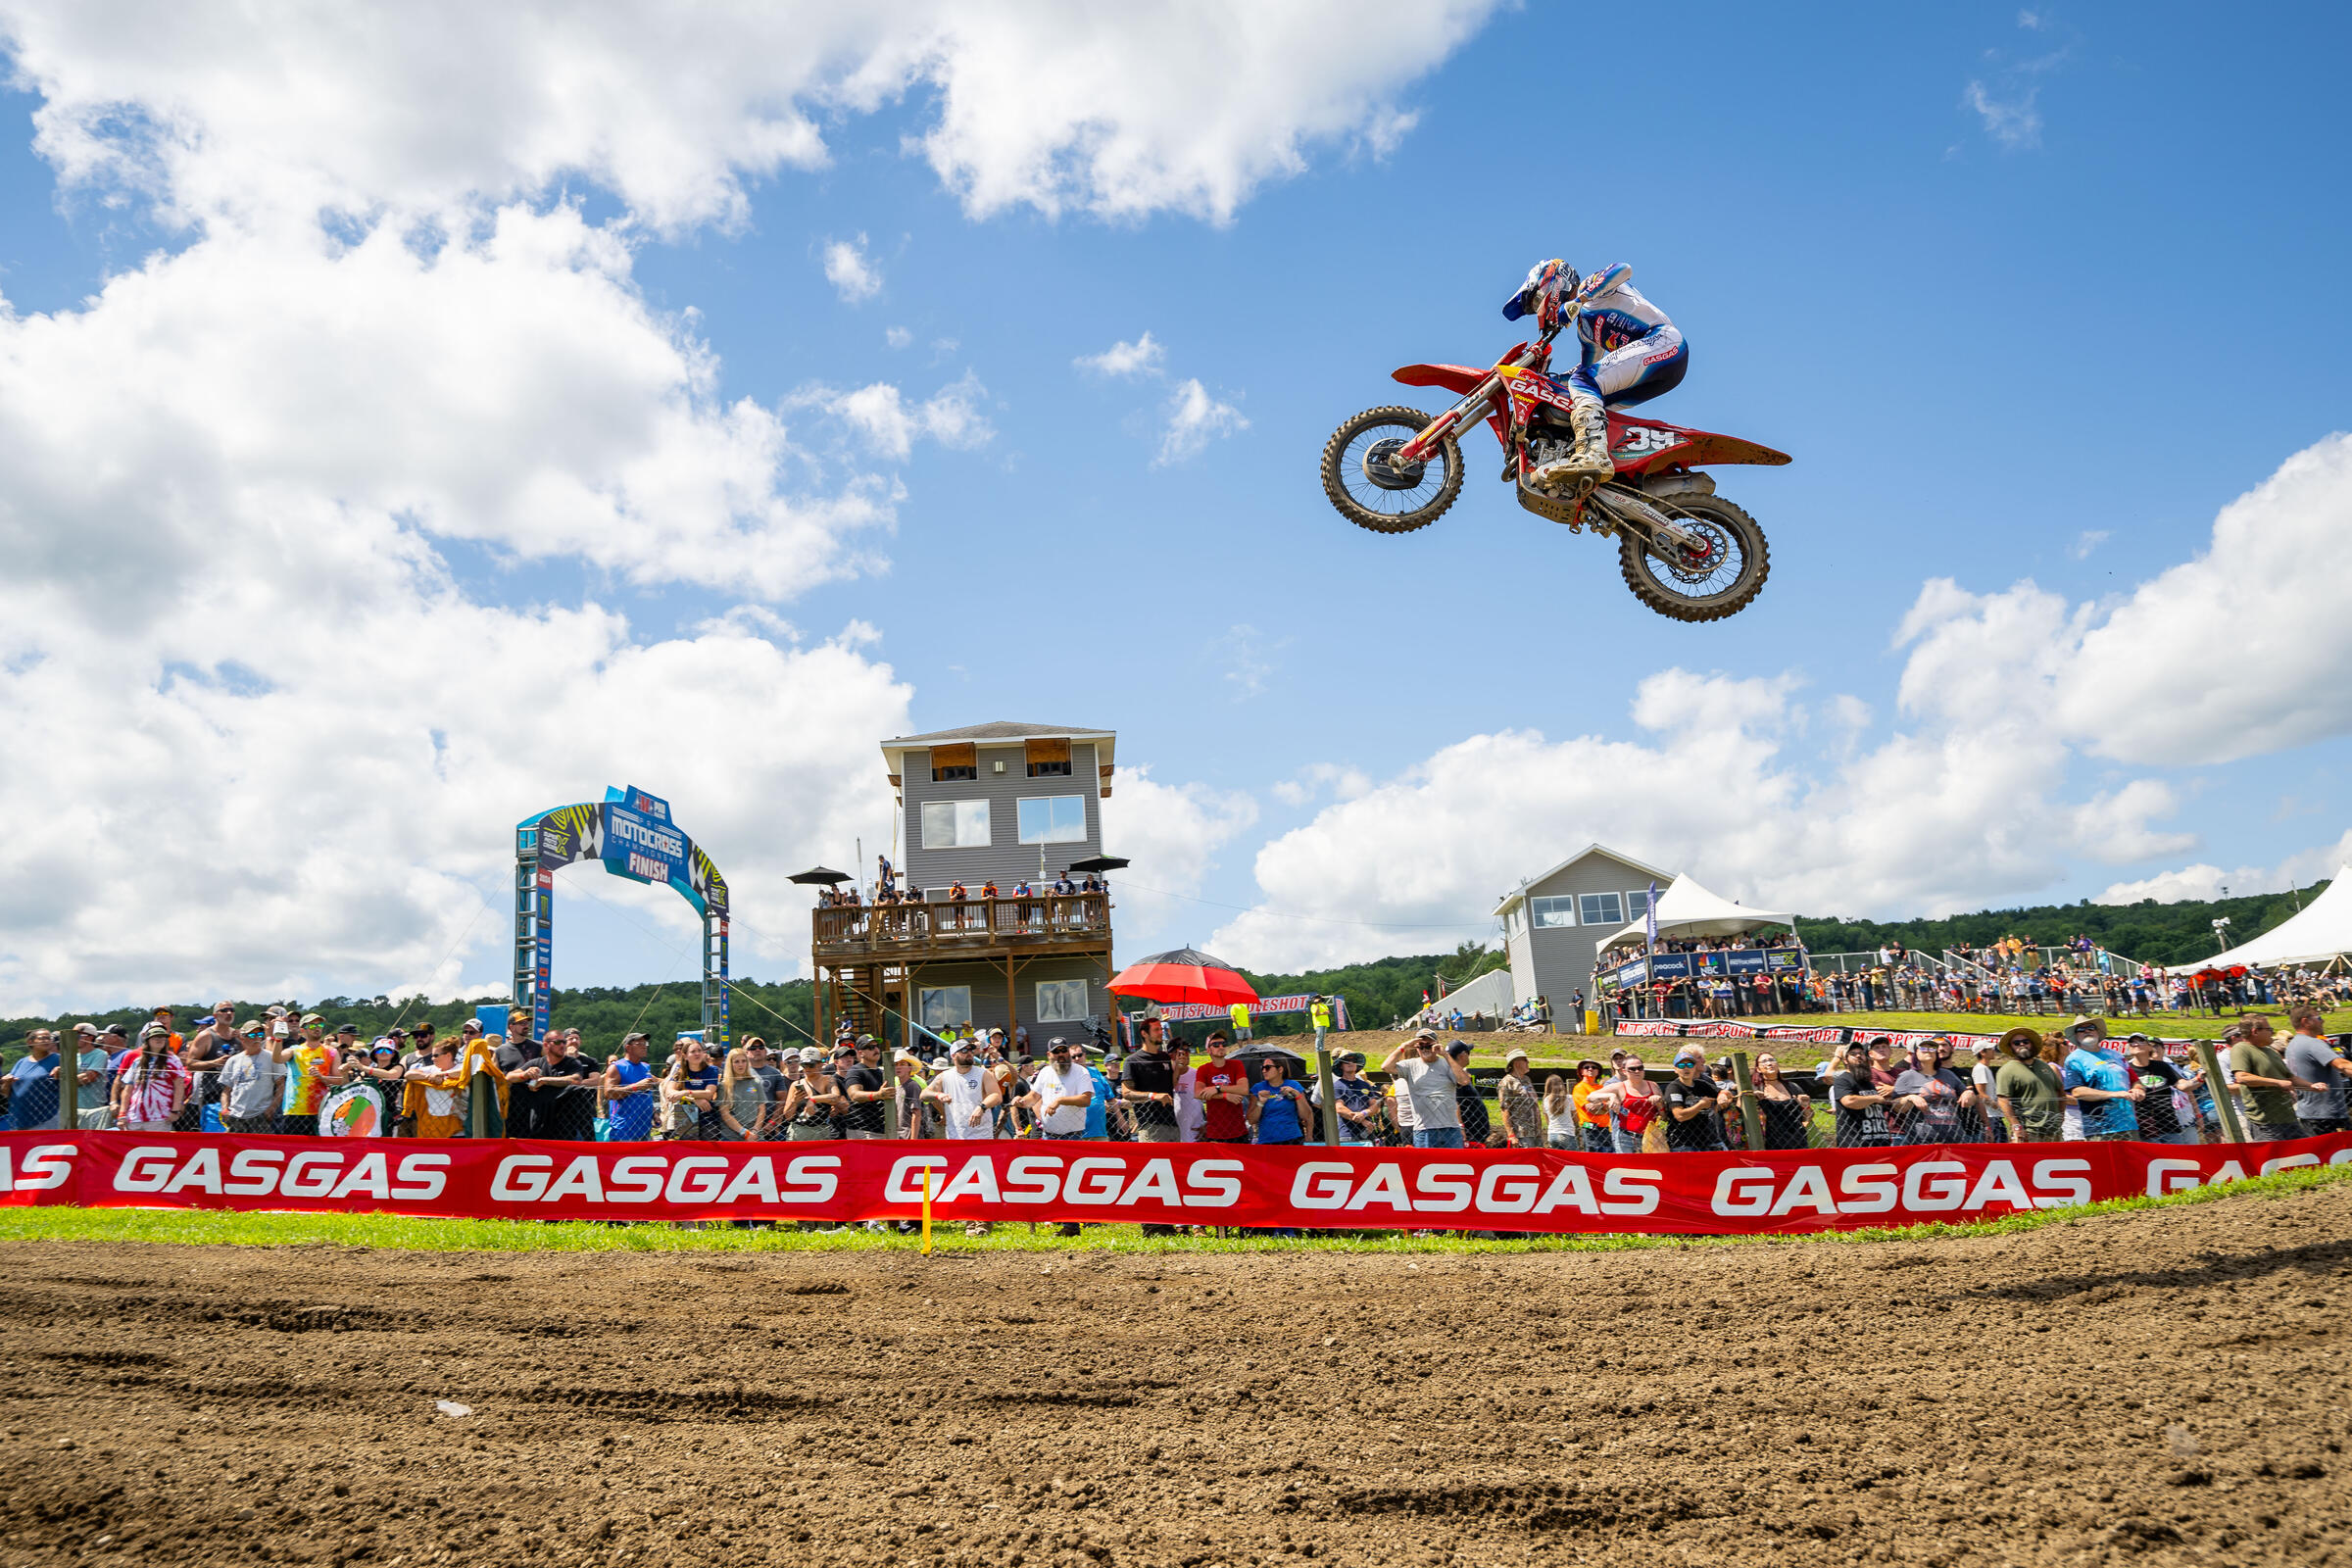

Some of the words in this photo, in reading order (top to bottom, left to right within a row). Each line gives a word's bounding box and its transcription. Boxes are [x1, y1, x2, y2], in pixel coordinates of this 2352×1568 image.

[1644, 347, 1679, 366] GASGAS
[1510, 379, 1576, 410] GASG
[1626, 426, 1674, 451] 39
[612, 815, 683, 858] MOTOCROSS
[612, 836, 683, 865] CHAMPIONSHIP
[629, 852, 669, 882] FINISH
[1653, 961, 1685, 973] peacock
[114, 1147, 451, 1200] GASGAS
[491, 1155, 841, 1202] GASGAS
[885, 1156, 1244, 1206] GASGAS
[1291, 1162, 1662, 1214] GASGAS
[1711, 1159, 2090, 1215] GASGAS
